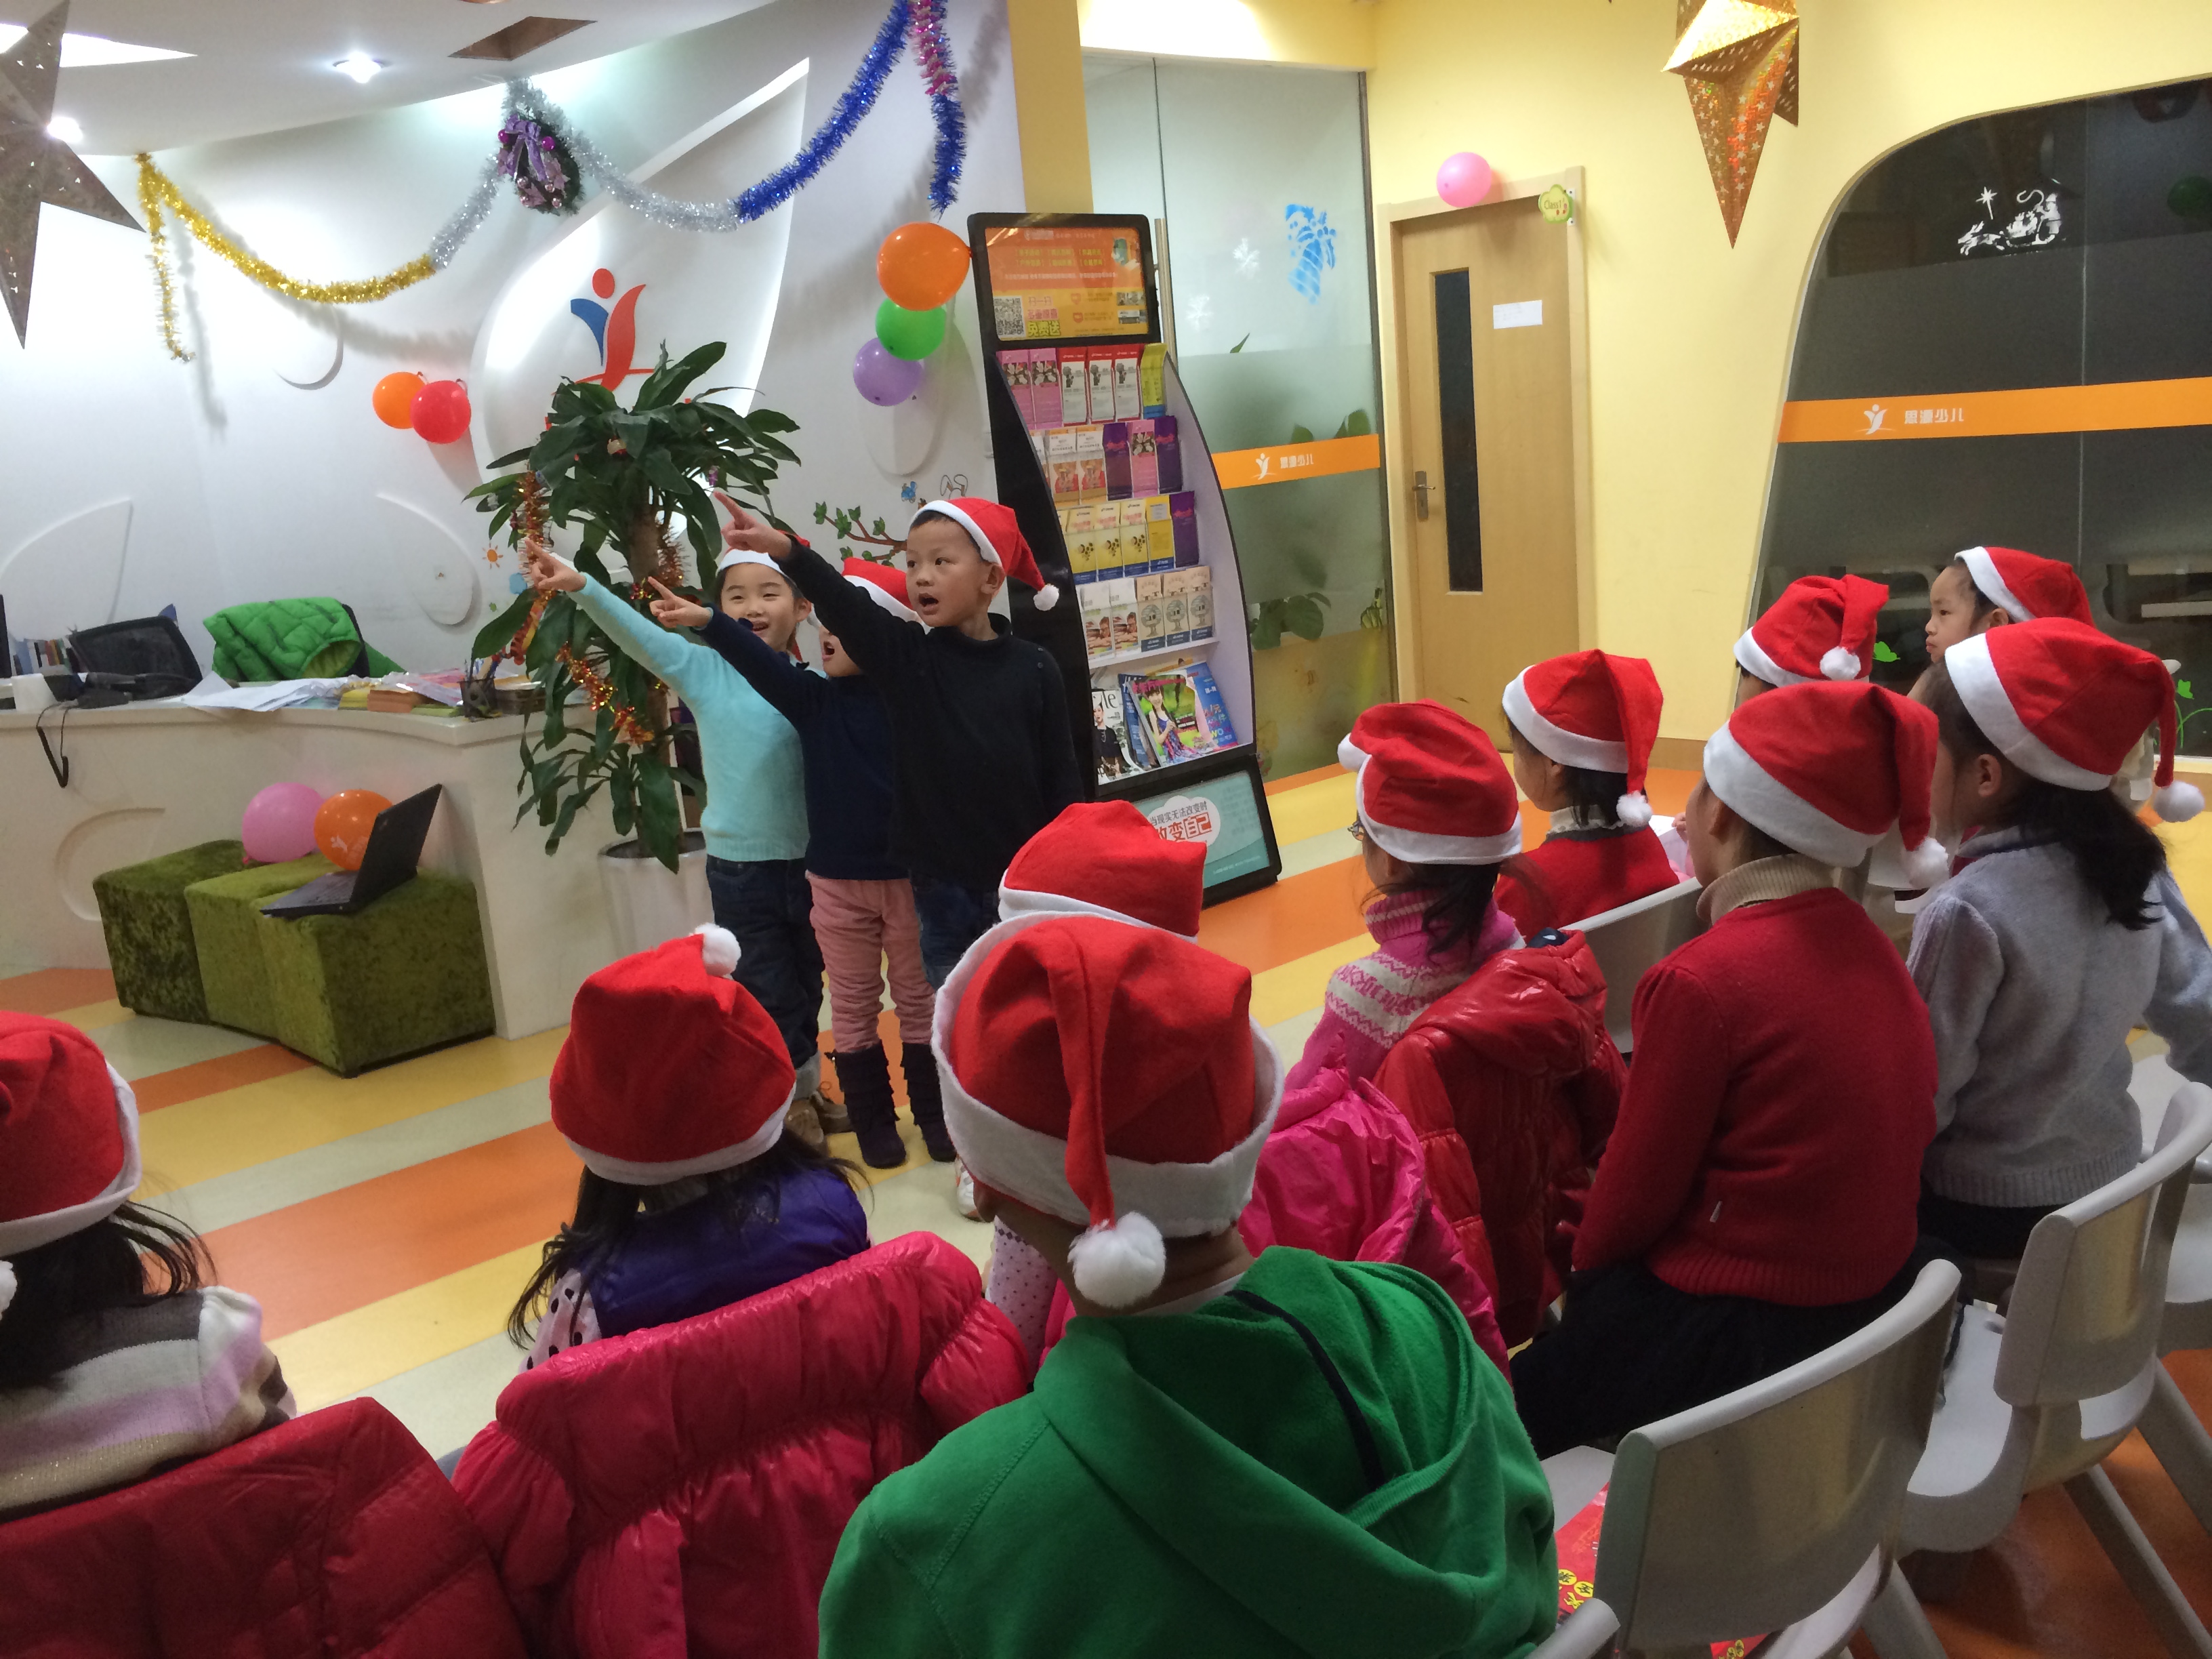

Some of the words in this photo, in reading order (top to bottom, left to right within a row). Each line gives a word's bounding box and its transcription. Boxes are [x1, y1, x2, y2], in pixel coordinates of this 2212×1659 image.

[1027, 321, 1061, 337] 免费送
[1150, 800, 1208, 826] 当现实无法改变时
